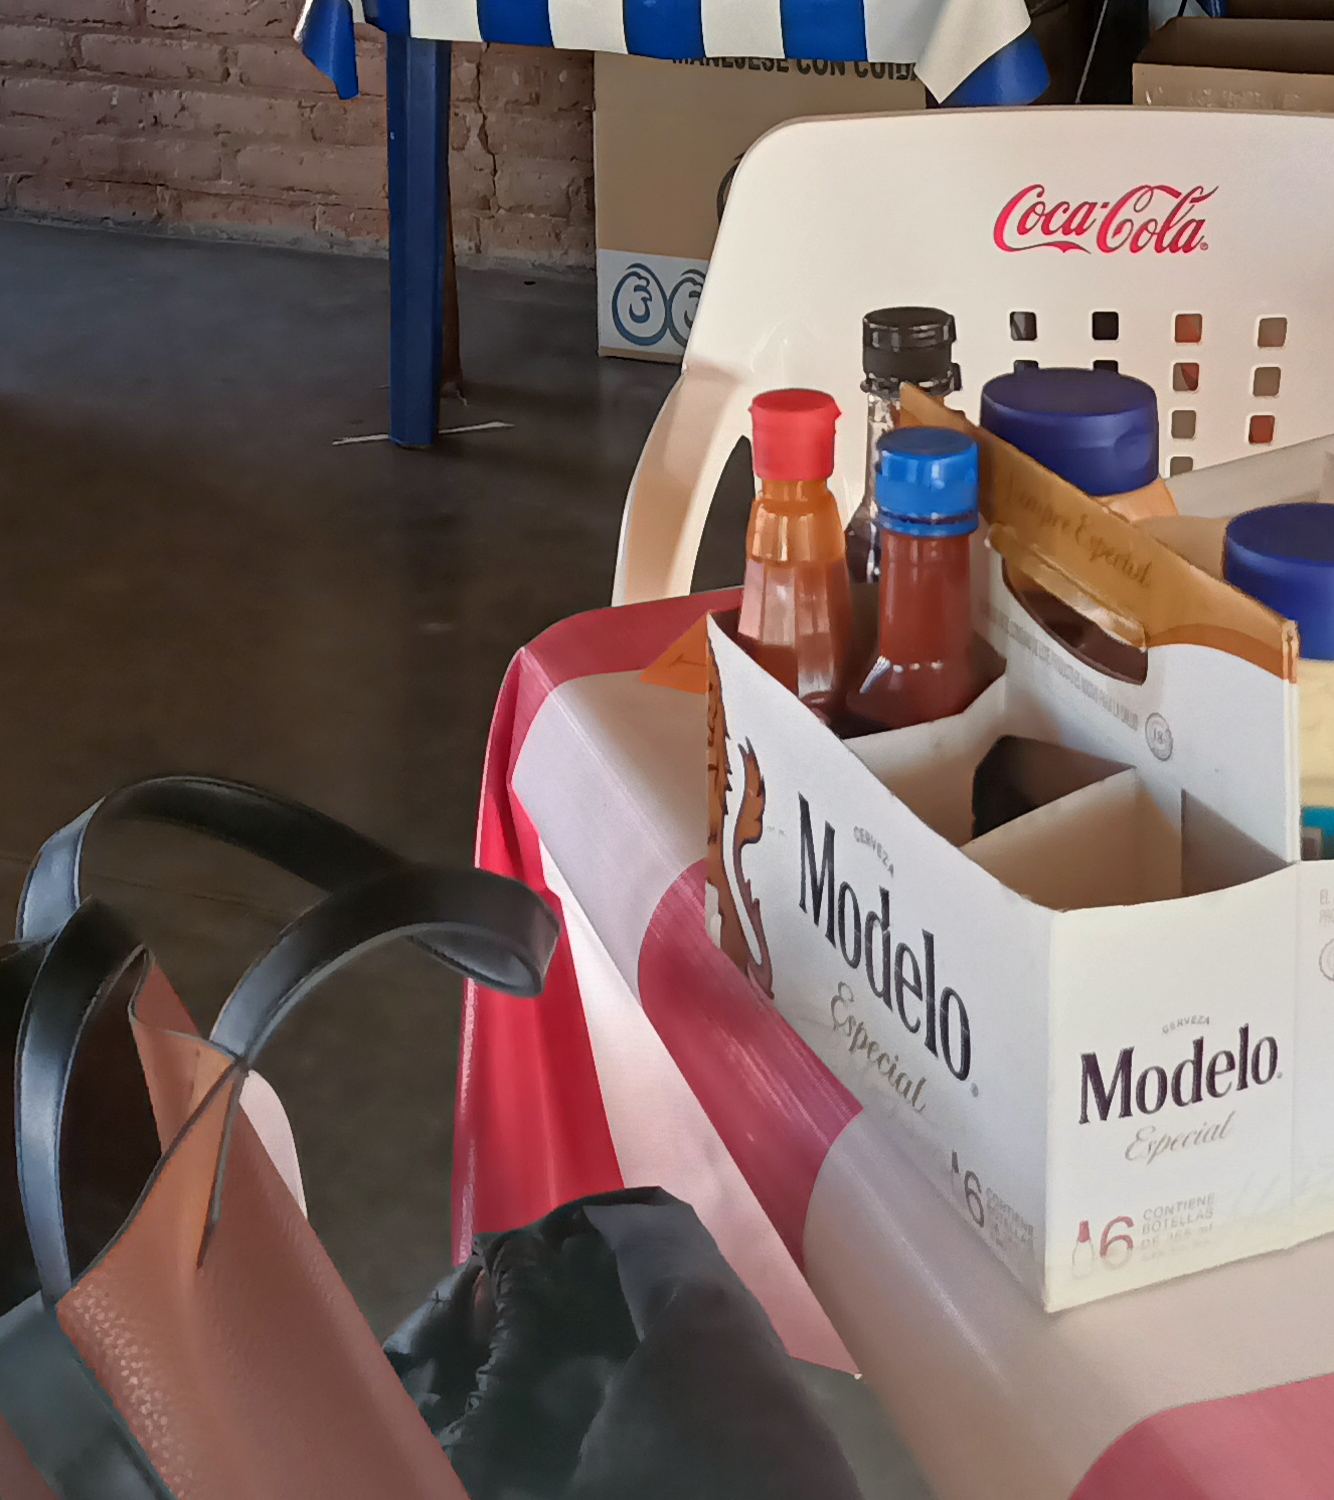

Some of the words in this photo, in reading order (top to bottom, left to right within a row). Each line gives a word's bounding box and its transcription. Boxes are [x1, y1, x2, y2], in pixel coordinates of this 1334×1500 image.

[993, 184, 1219, 254] Coca-Cola
[853, 825, 895, 878] CERVEZA
[798, 790, 971, 1082] Modelo
[831, 980, 928, 1113] Especial
[1162, 1014, 1211, 1036] CERVEZA
[1078, 1022, 1279, 1125] Modelo
[1124, 1110, 1236, 1166] Especial
[964, 1169, 985, 1228] 6
[1142, 1209, 1214, 1236] BOTELLAS
[1143, 1192, 1216, 1221] CONTIENE
[1099, 1215, 1134, 1270] 6
